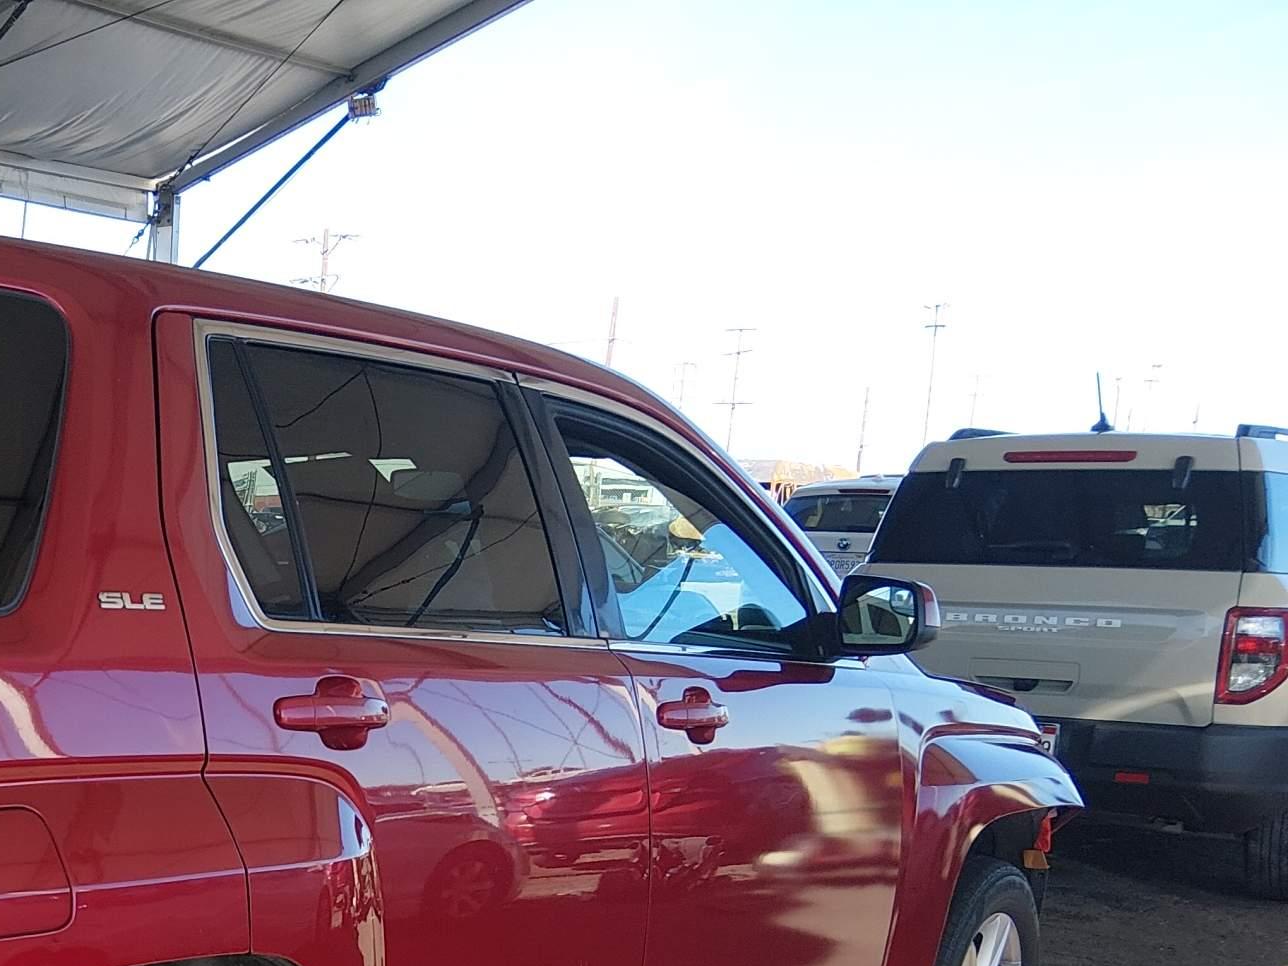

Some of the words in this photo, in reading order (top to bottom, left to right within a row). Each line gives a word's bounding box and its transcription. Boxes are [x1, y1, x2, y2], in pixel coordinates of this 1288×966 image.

[98, 591, 166, 610] SLE
[945, 613, 1122, 628] BRONCO
[997, 625, 1059, 633] SPORT
